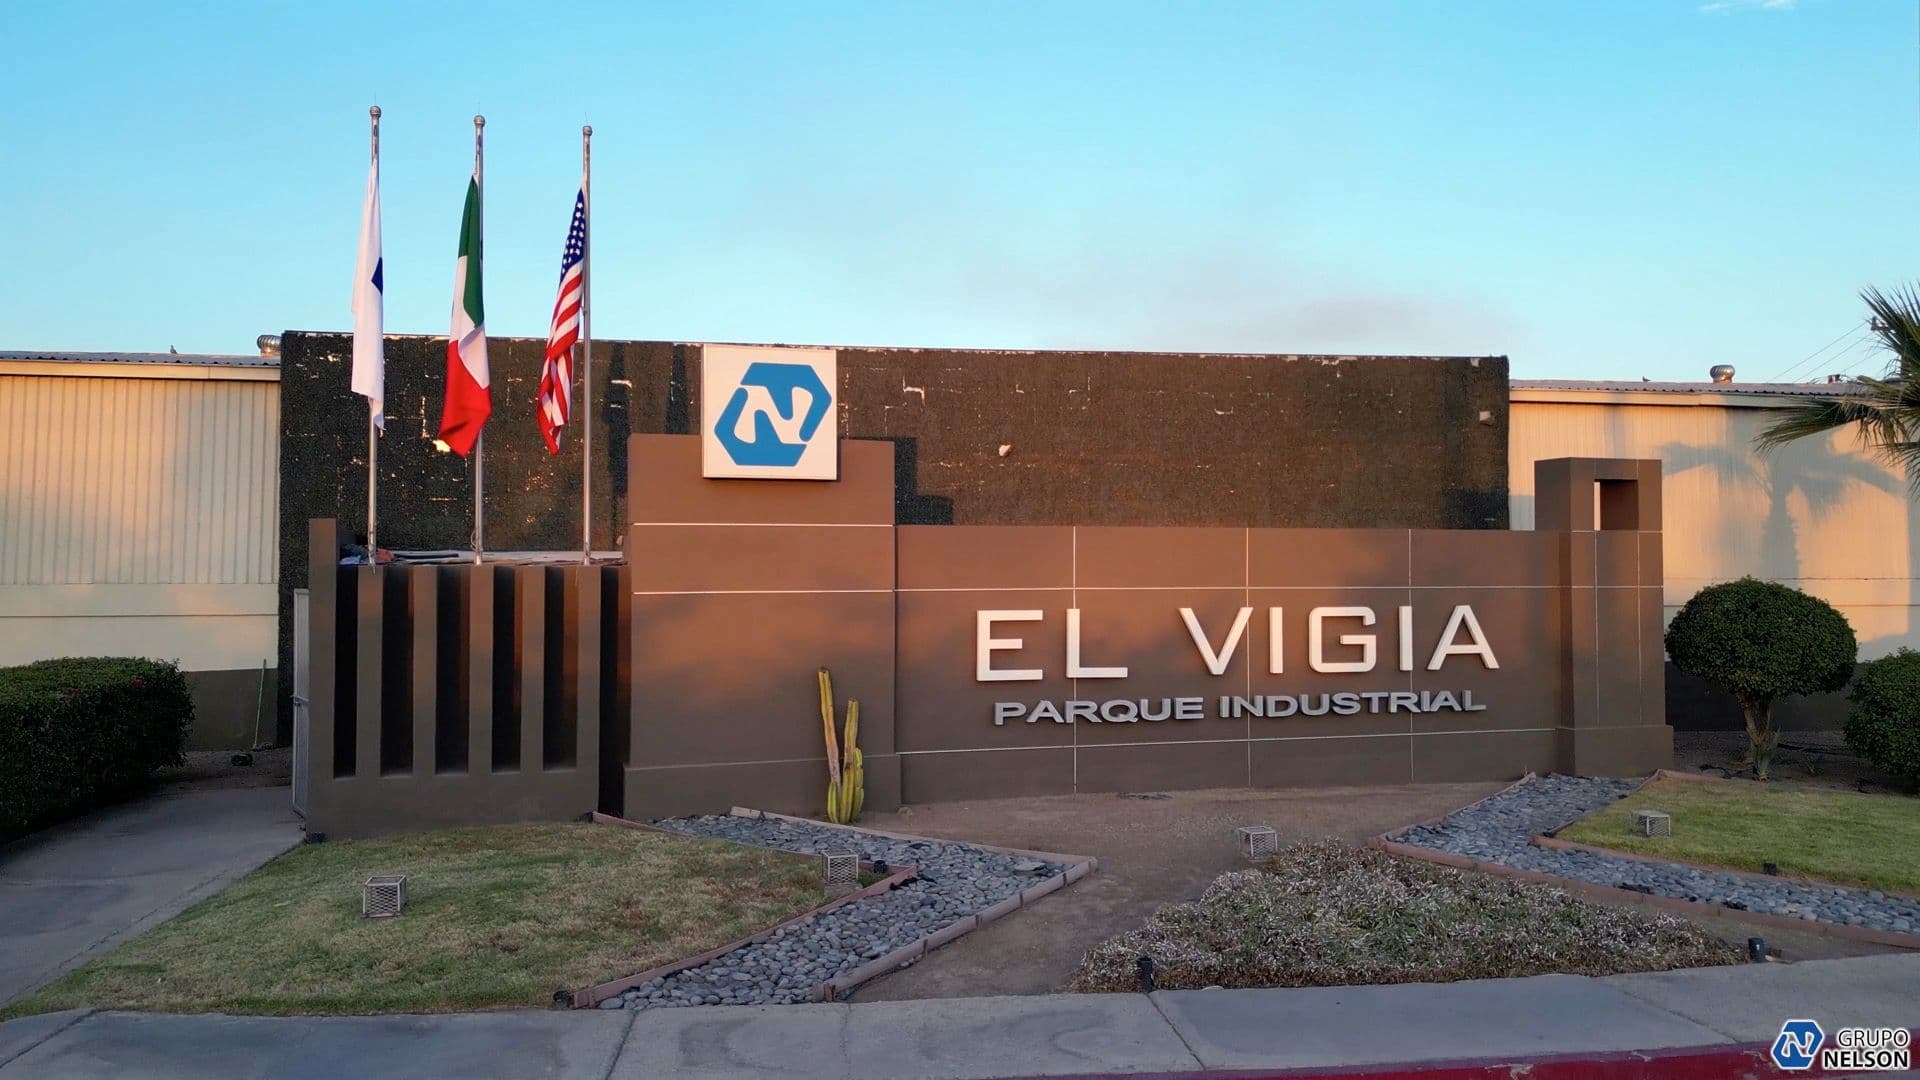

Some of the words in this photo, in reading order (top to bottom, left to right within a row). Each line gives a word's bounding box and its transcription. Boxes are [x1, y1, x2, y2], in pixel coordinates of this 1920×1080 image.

[976, 608, 1128, 681] EL
[1178, 605, 1500, 675] VIGIA
[994, 697, 1204, 726] PARQUE
[1219, 689, 1487, 719] INDUSTRIAL
